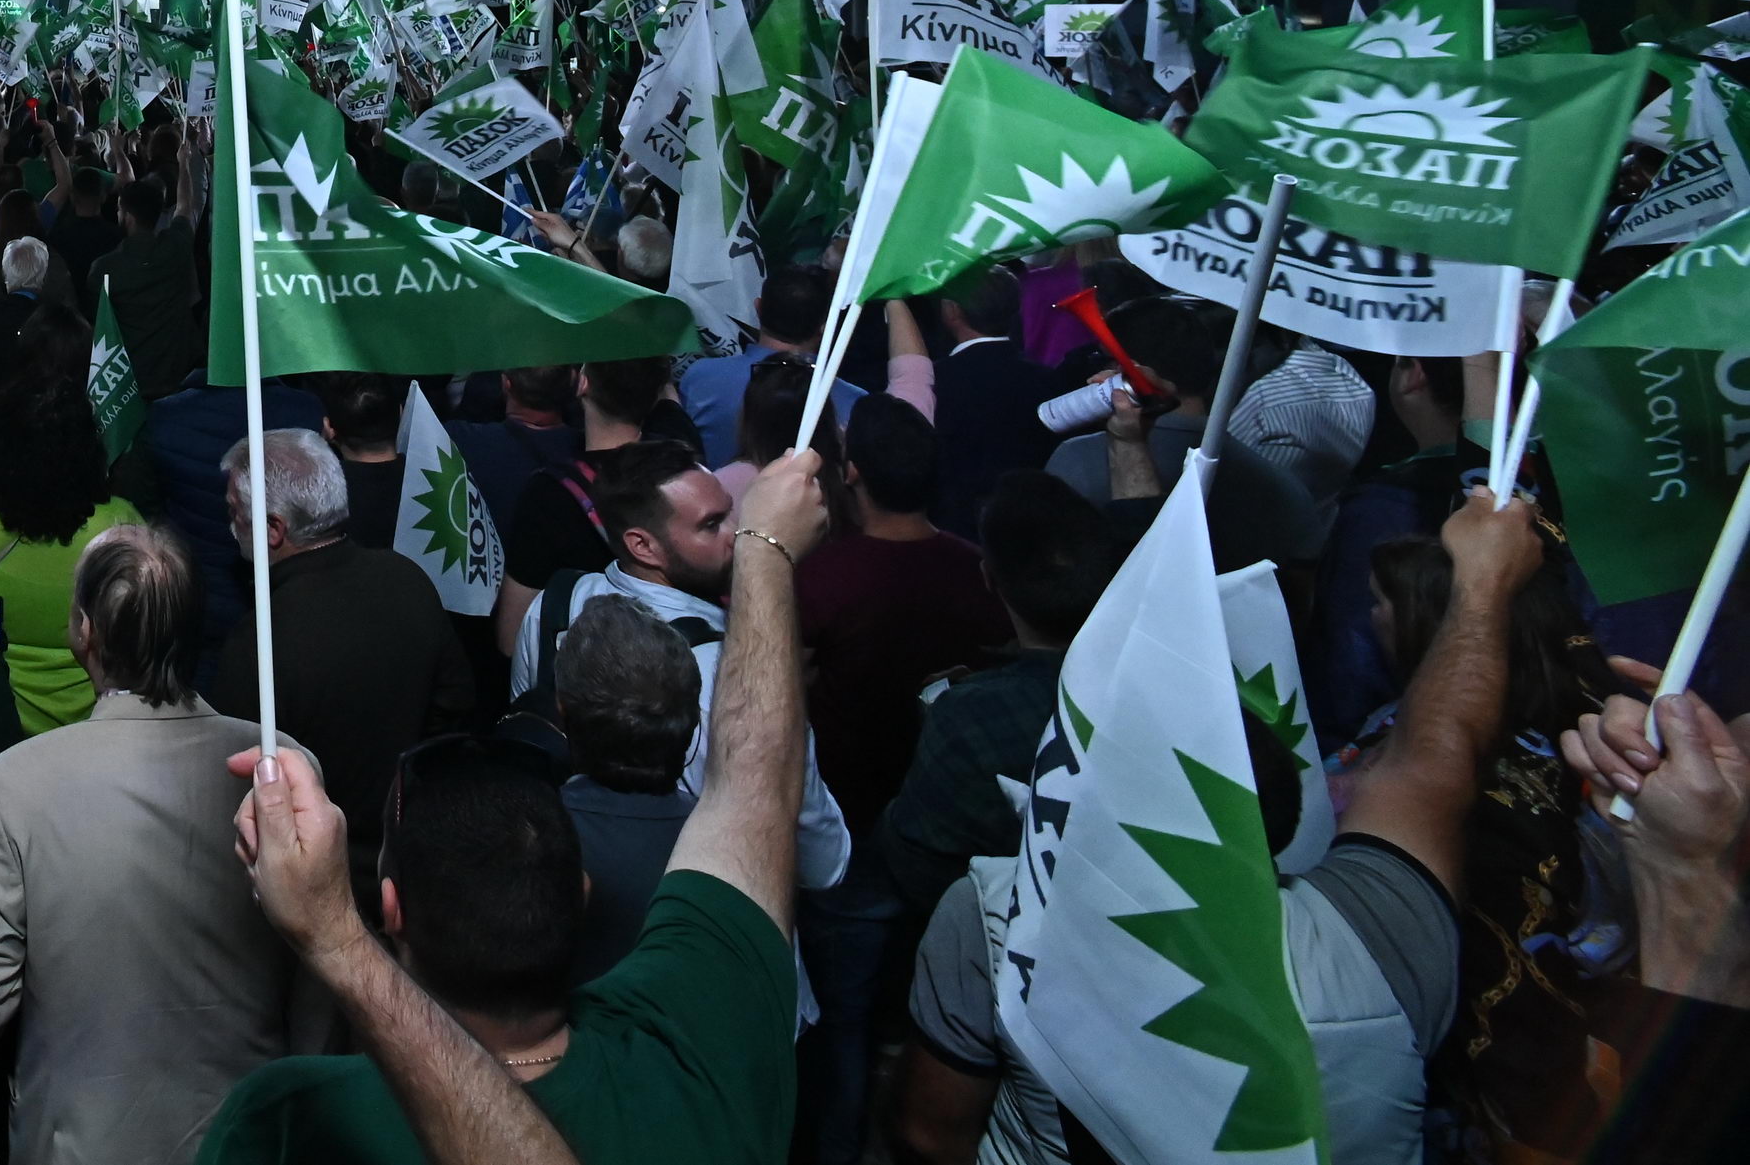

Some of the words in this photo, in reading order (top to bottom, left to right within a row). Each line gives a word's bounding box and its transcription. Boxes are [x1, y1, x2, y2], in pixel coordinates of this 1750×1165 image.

[901, 12, 1022, 59] Κίνημα
[444, 107, 531, 159] ΠΑΣΟΚ
[256, 261, 382, 304] ίνημα
